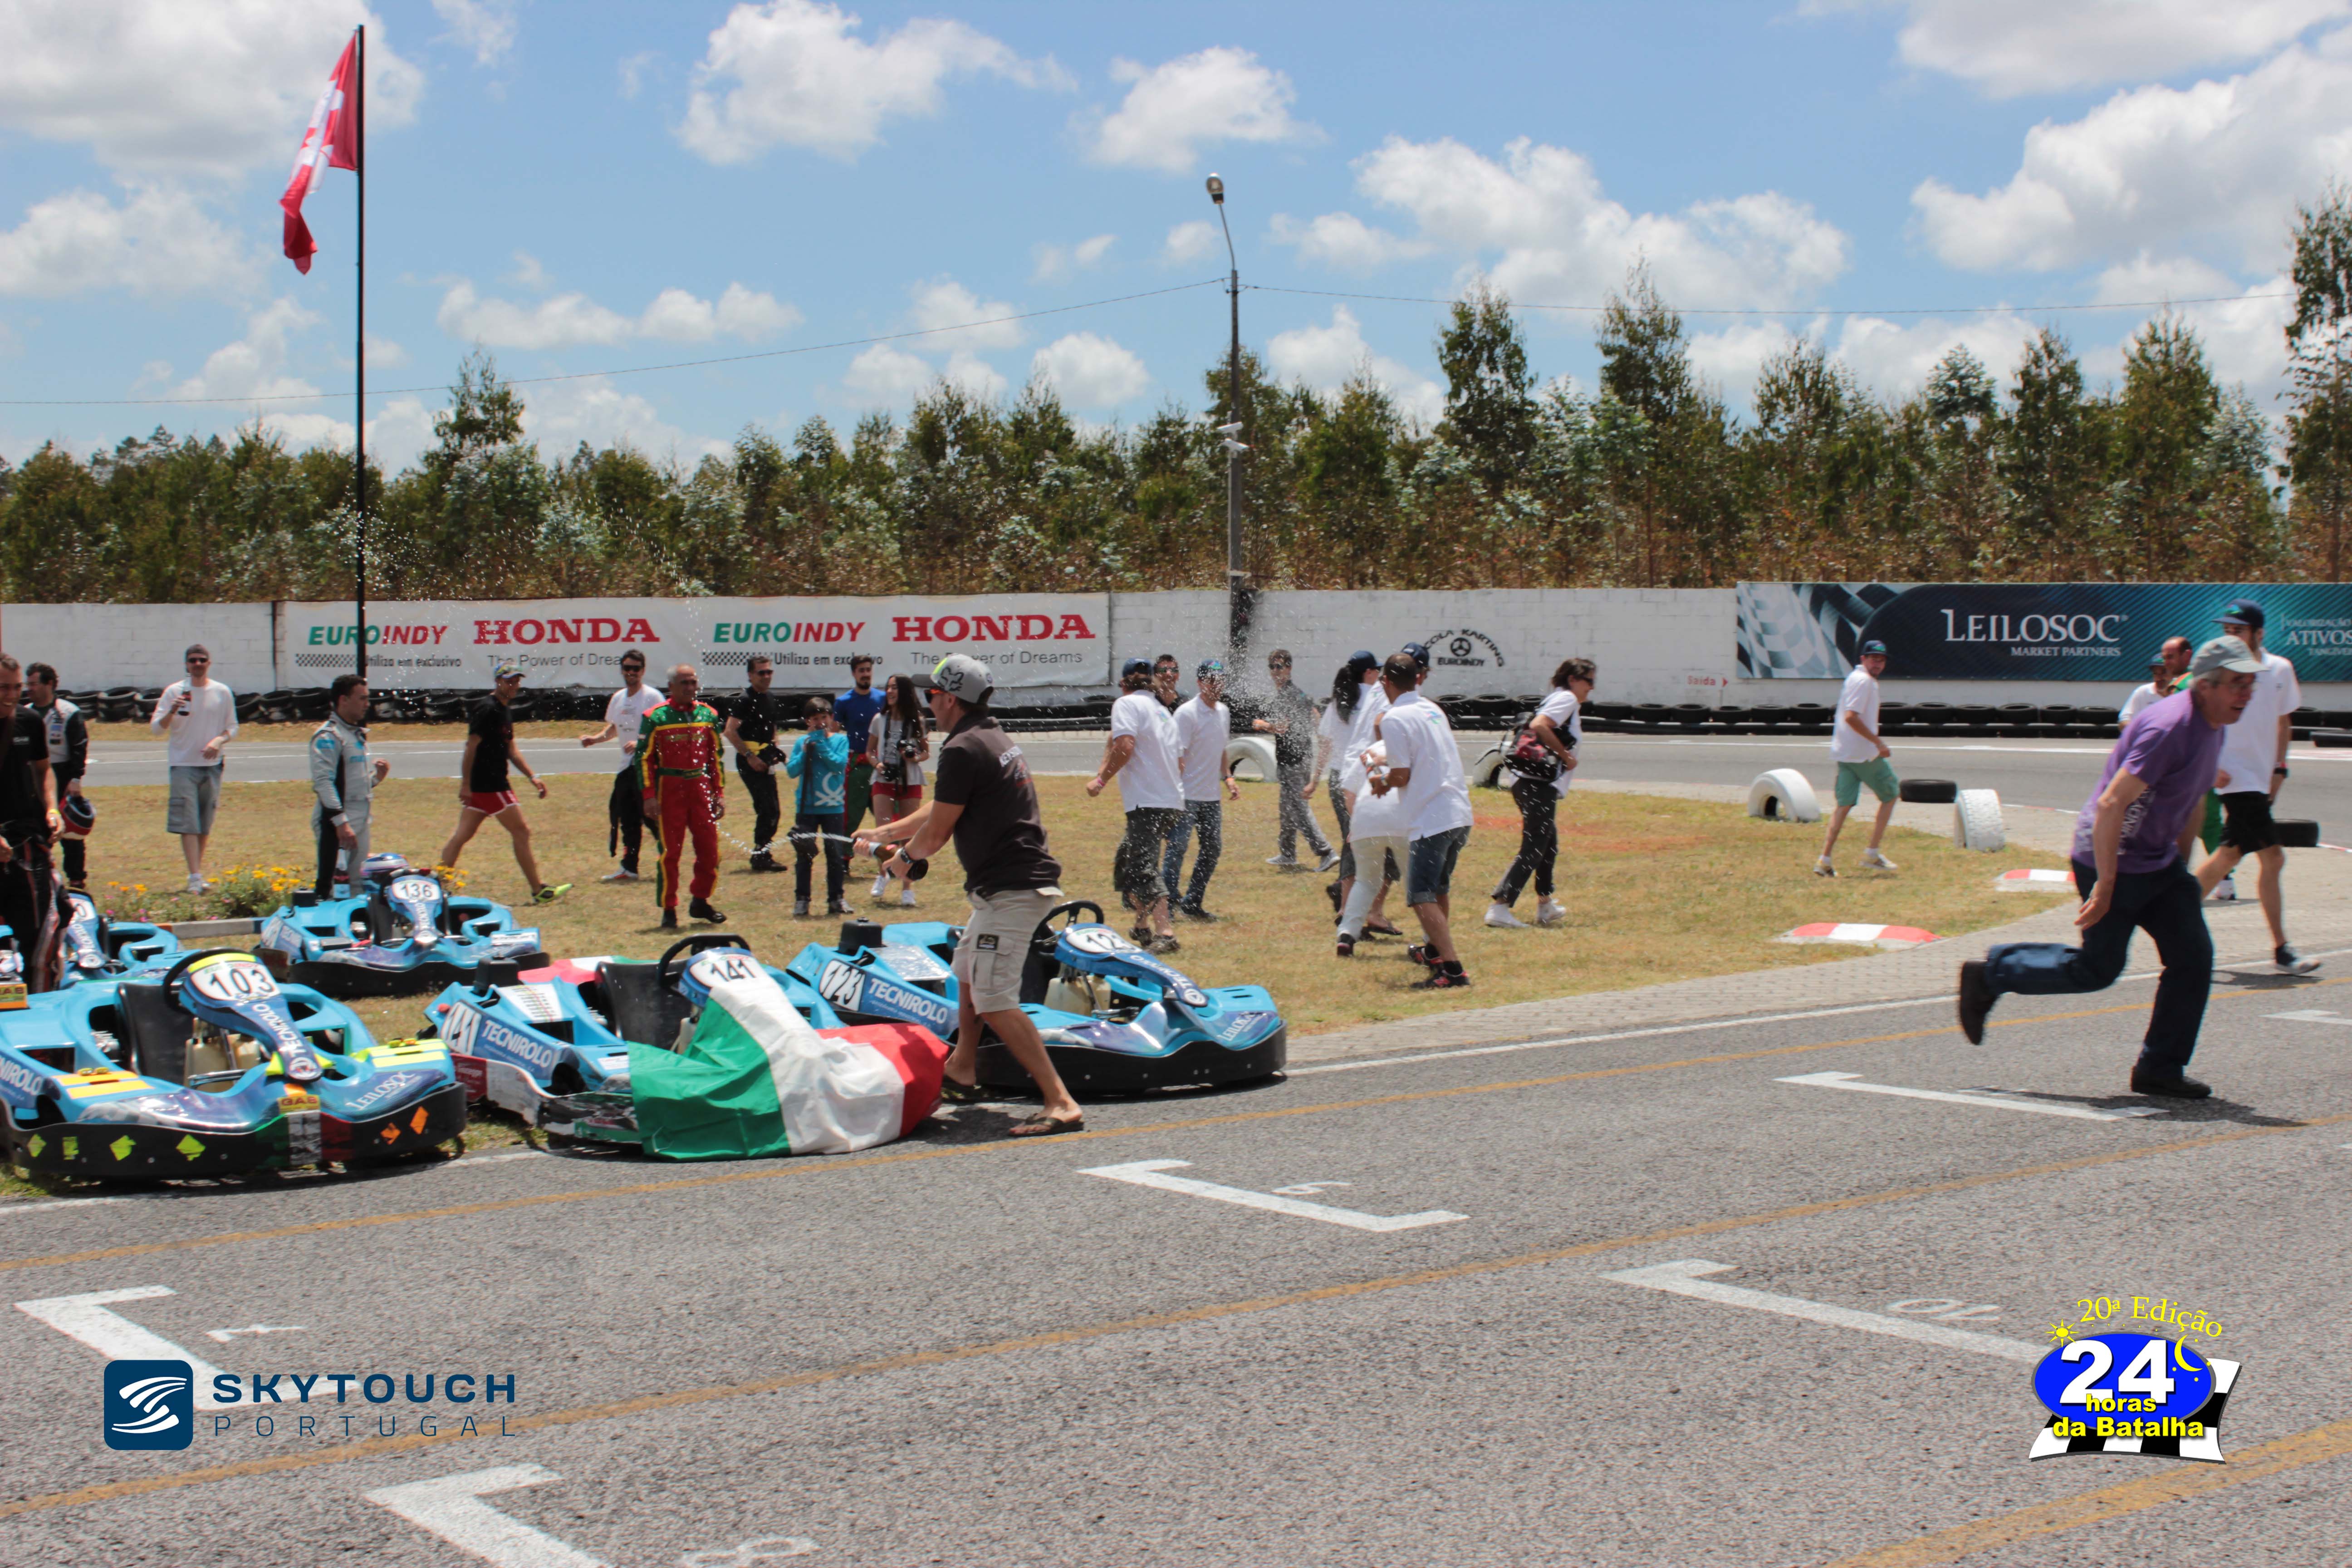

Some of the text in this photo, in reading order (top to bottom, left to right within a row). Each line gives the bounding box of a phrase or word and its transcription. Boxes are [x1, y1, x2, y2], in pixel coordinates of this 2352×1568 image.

[473, 618, 661, 645] HONDA
[713, 622, 865, 643] EUROINDY
[892, 614, 1096, 642] HONDA
[1424, 630, 1454, 650] COLA
[519, 654, 565, 667] Power
[570, 653, 585, 666] of
[588, 653, 622, 666] Drea
[774, 652, 809, 665] Utiliza
[813, 656, 830, 665] em
[1000, 651, 1016, 664] of
[1020, 651, 1083, 664] Dreams
[2011, 647, 2122, 657] MARKET PARTNERS
[400, 883, 432, 898] 136
[710, 959, 756, 982] 141
[209, 968, 274, 997] 103
[868, 977, 949, 1024] TECNIROLO
[481, 1019, 553, 1068] TECNIROLO
[0, 1055, 43, 1096] NIROLO
